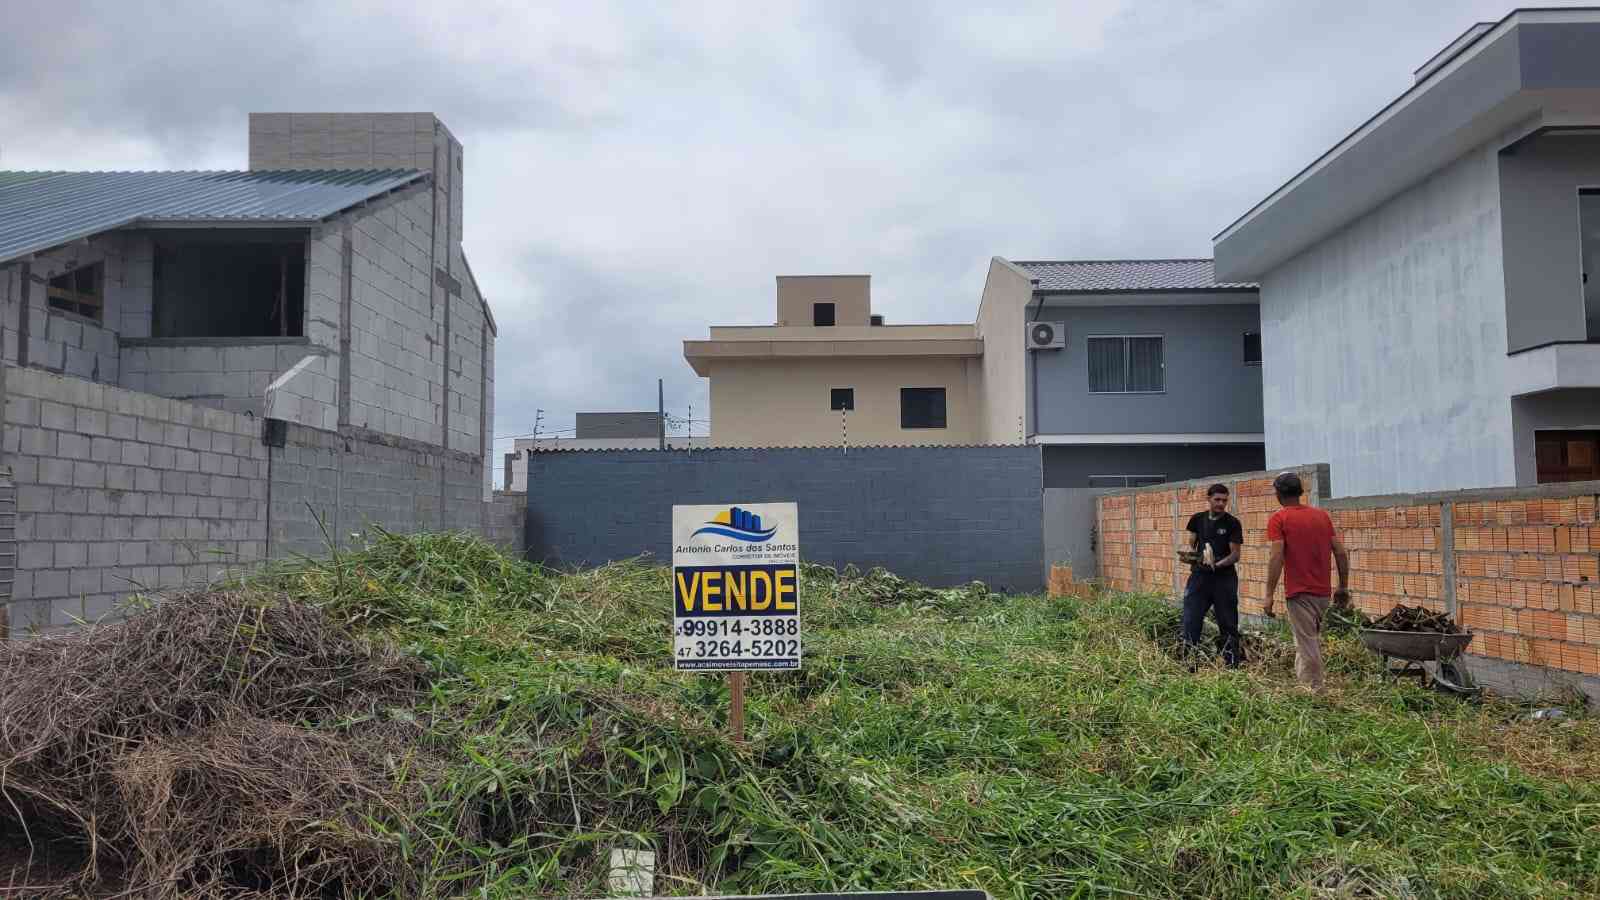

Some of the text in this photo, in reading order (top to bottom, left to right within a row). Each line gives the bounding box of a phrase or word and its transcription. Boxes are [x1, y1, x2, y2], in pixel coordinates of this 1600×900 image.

[675, 543, 796, 553] Antonio Carlos dos Santos
[676, 569, 796, 612] VENDE
[683, 619, 798, 637] 99914-3888
[678, 640, 798, 657] 47 3264-5202
